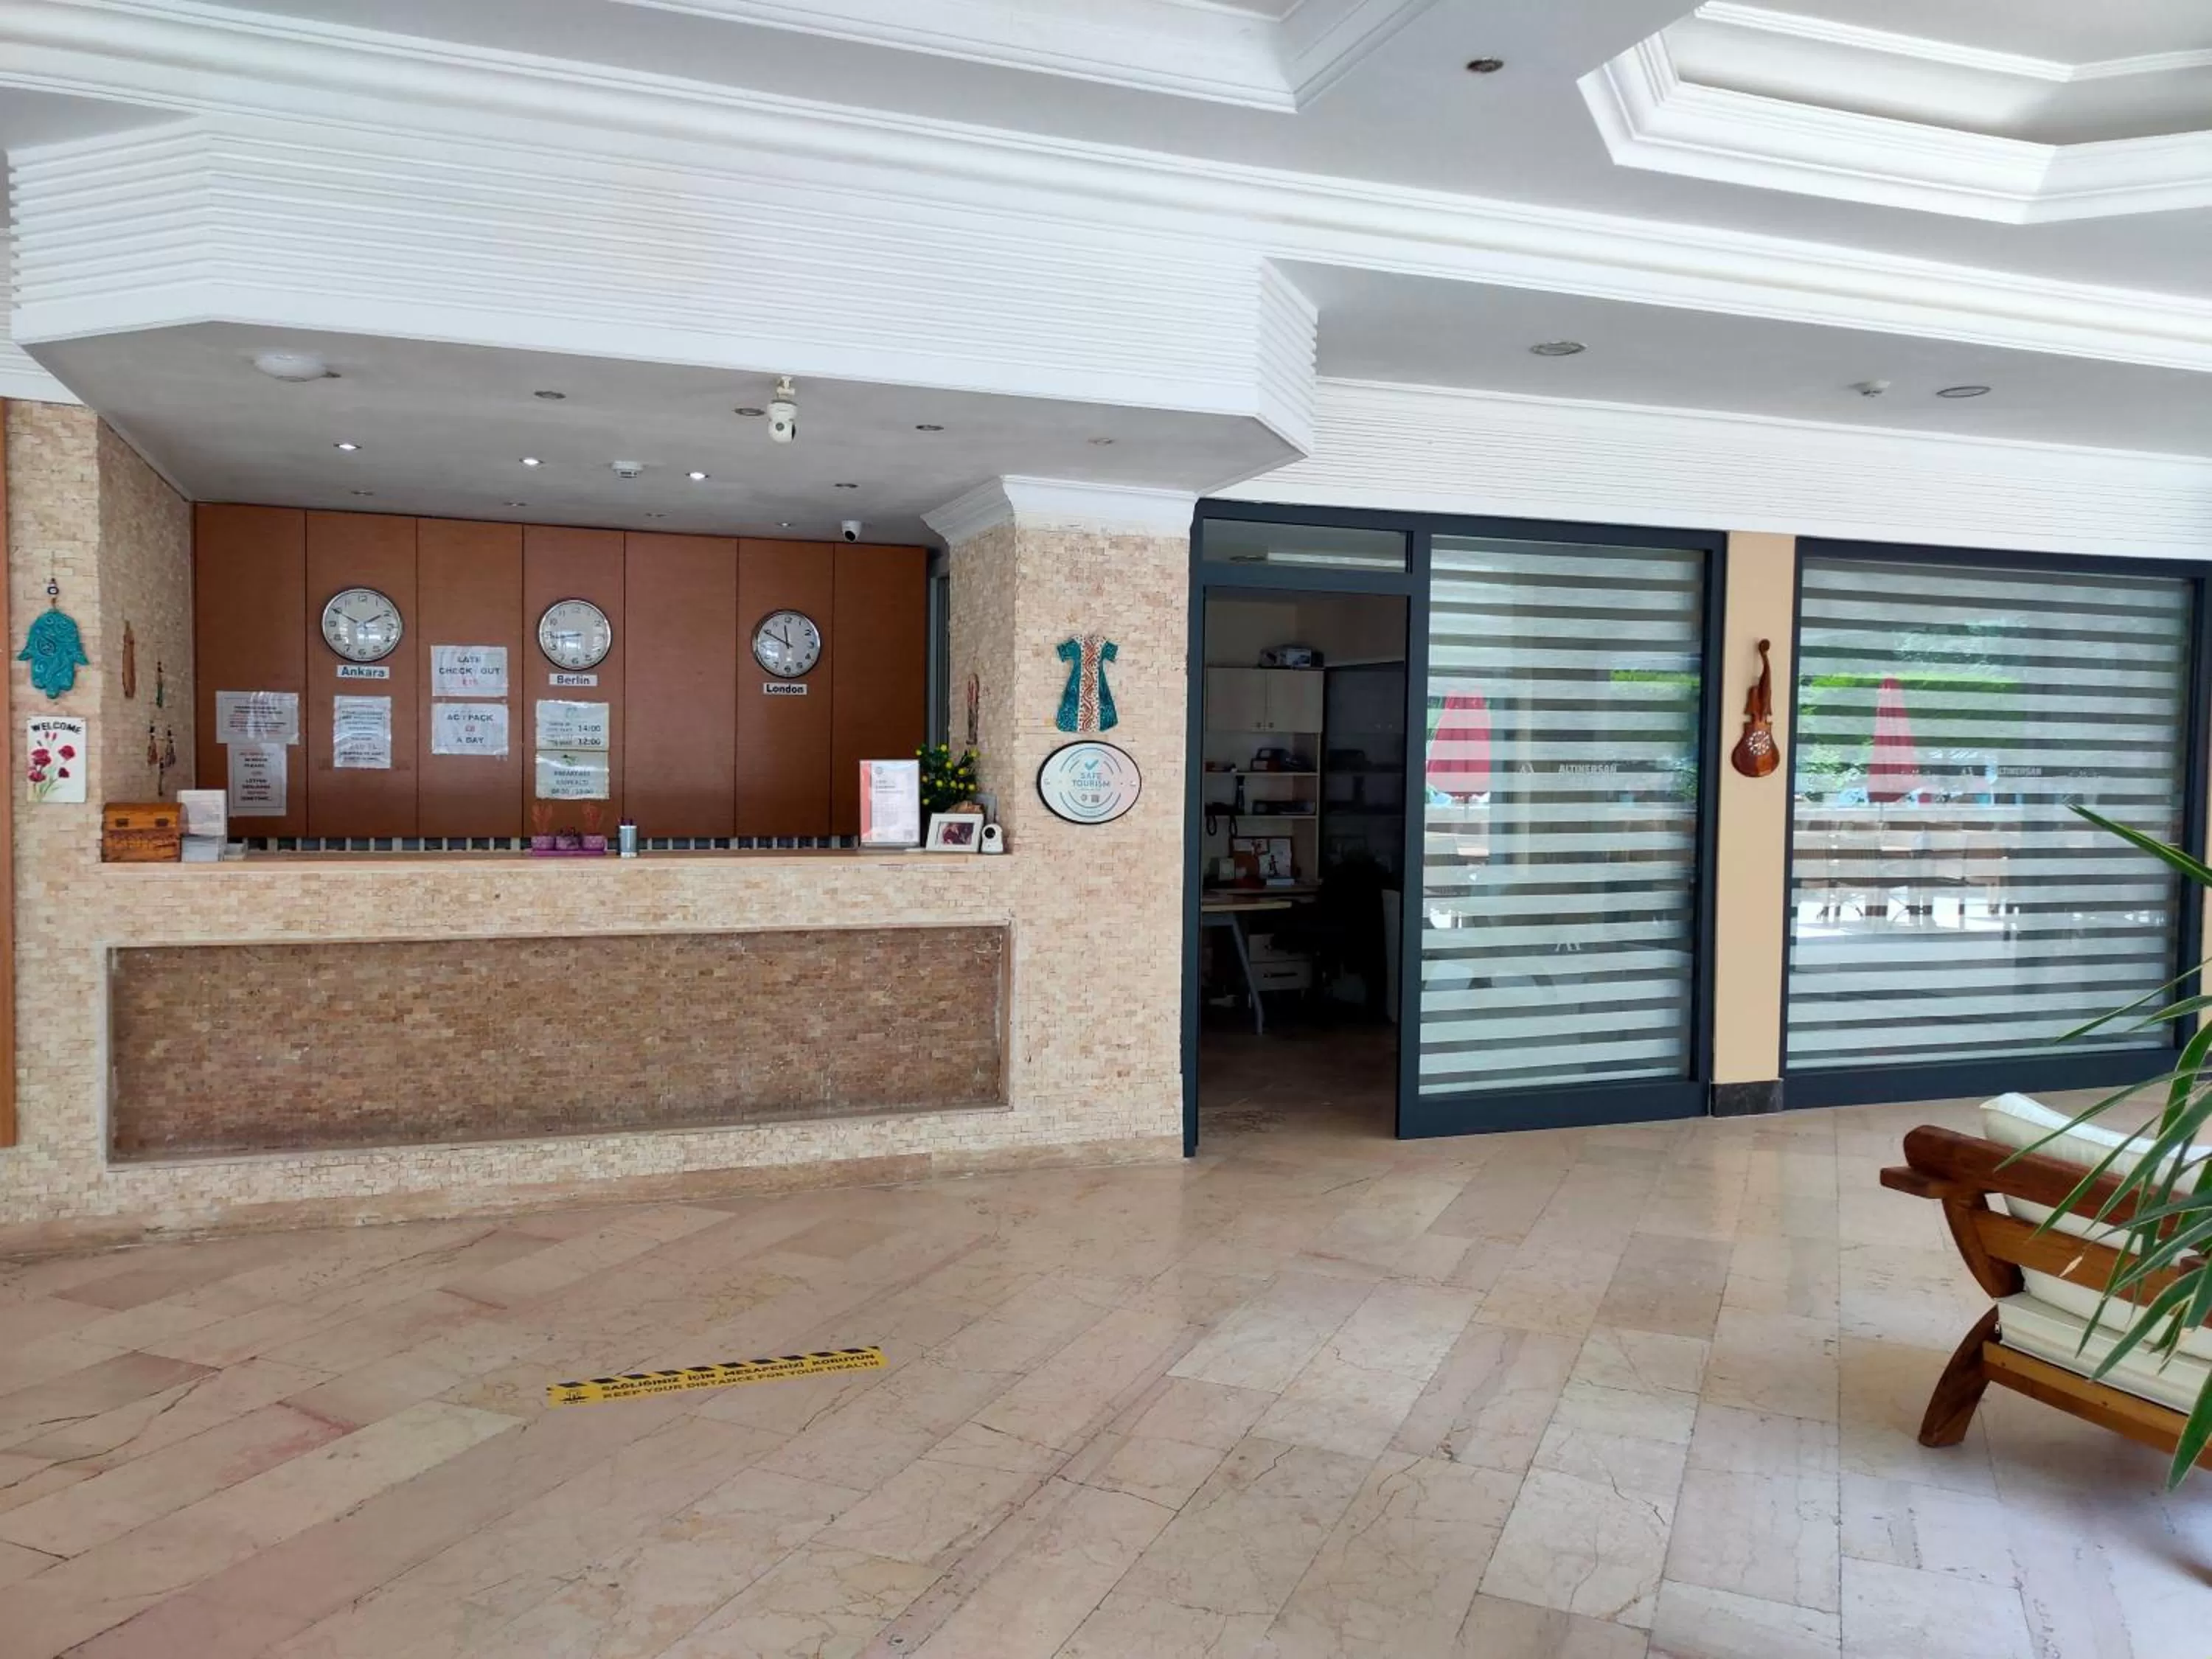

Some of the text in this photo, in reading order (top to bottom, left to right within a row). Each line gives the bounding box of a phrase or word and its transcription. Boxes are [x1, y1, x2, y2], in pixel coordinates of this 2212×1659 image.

[341, 666, 385, 677] Ankara
[557, 675, 590, 684] Berlin
[766, 684, 804, 693] London
[30, 722, 82, 734] WELCOME
[812, 1354, 876, 1366] KORUYUN
[602, 1360, 880, 1399] KEEP YOUR DISTANCE FOR YOUR HEALTH
